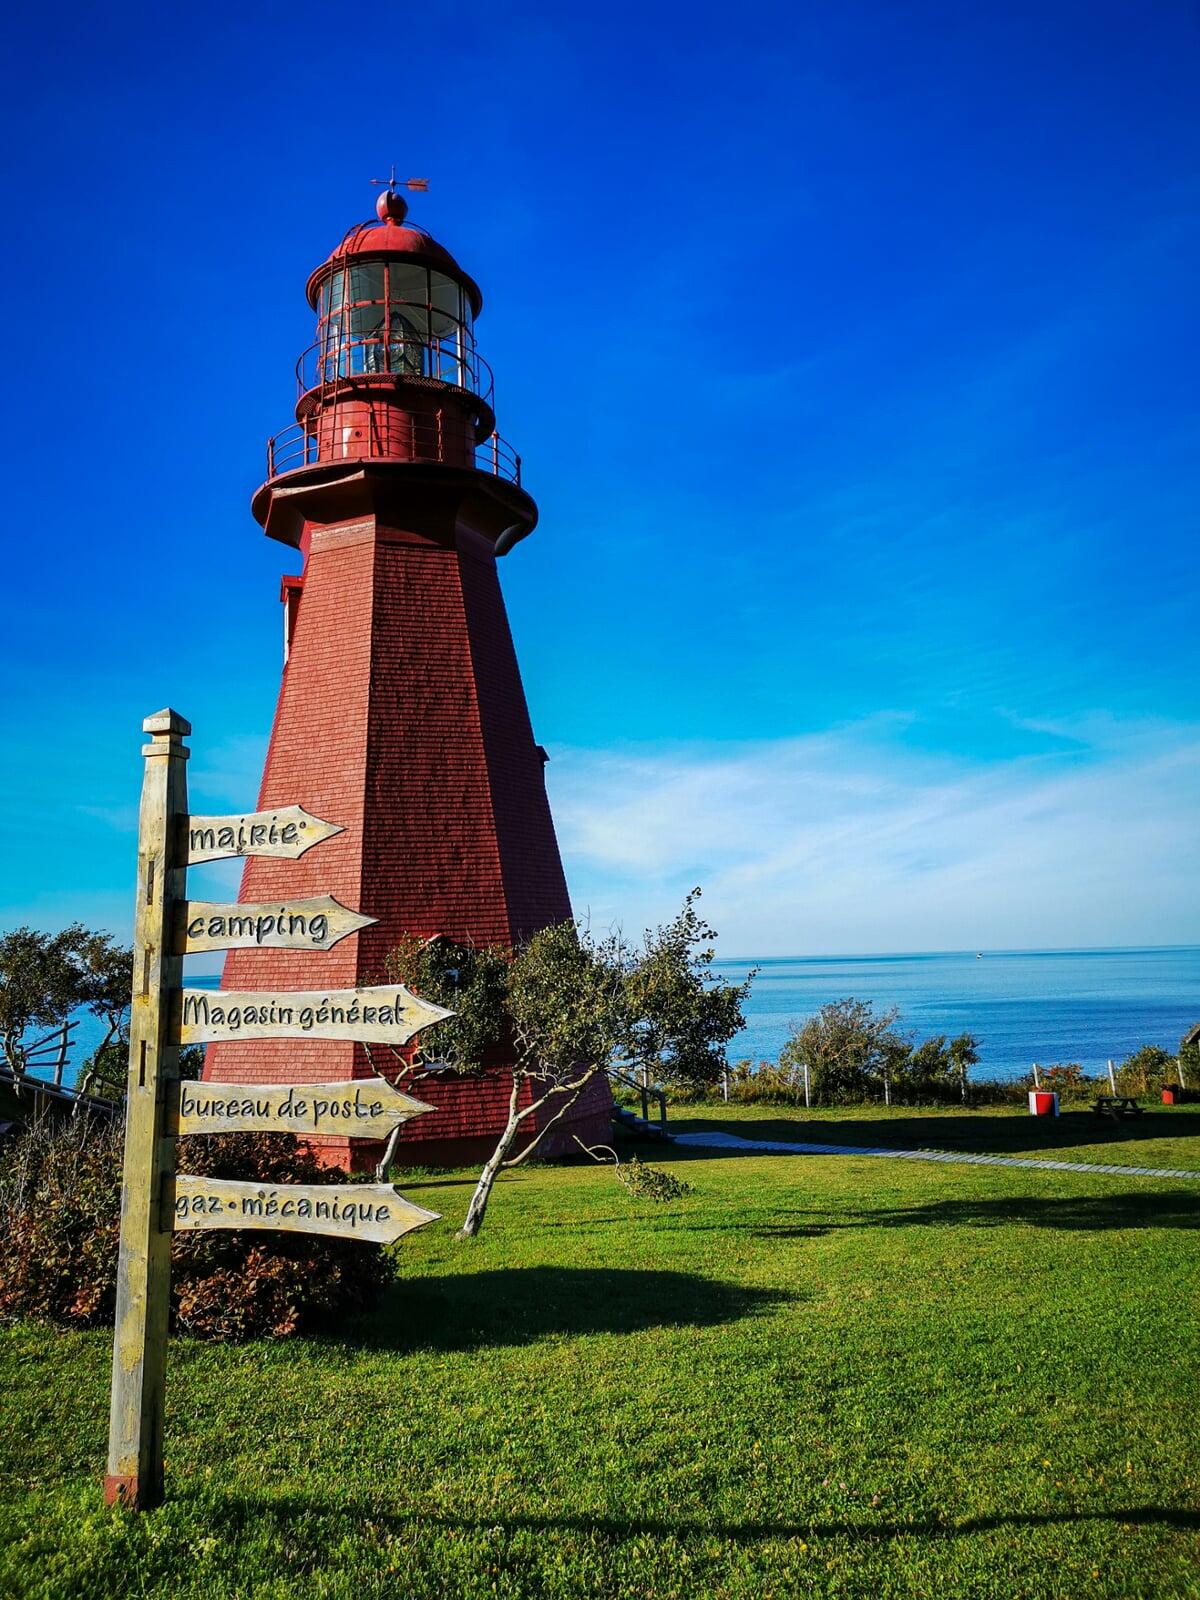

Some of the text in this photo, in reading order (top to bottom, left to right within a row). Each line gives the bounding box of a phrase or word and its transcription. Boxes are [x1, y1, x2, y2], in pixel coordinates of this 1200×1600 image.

[187, 907, 329, 944] camping
[183, 995, 294, 1031] Magasin
[181, 1088, 384, 1126] bureau de poste
